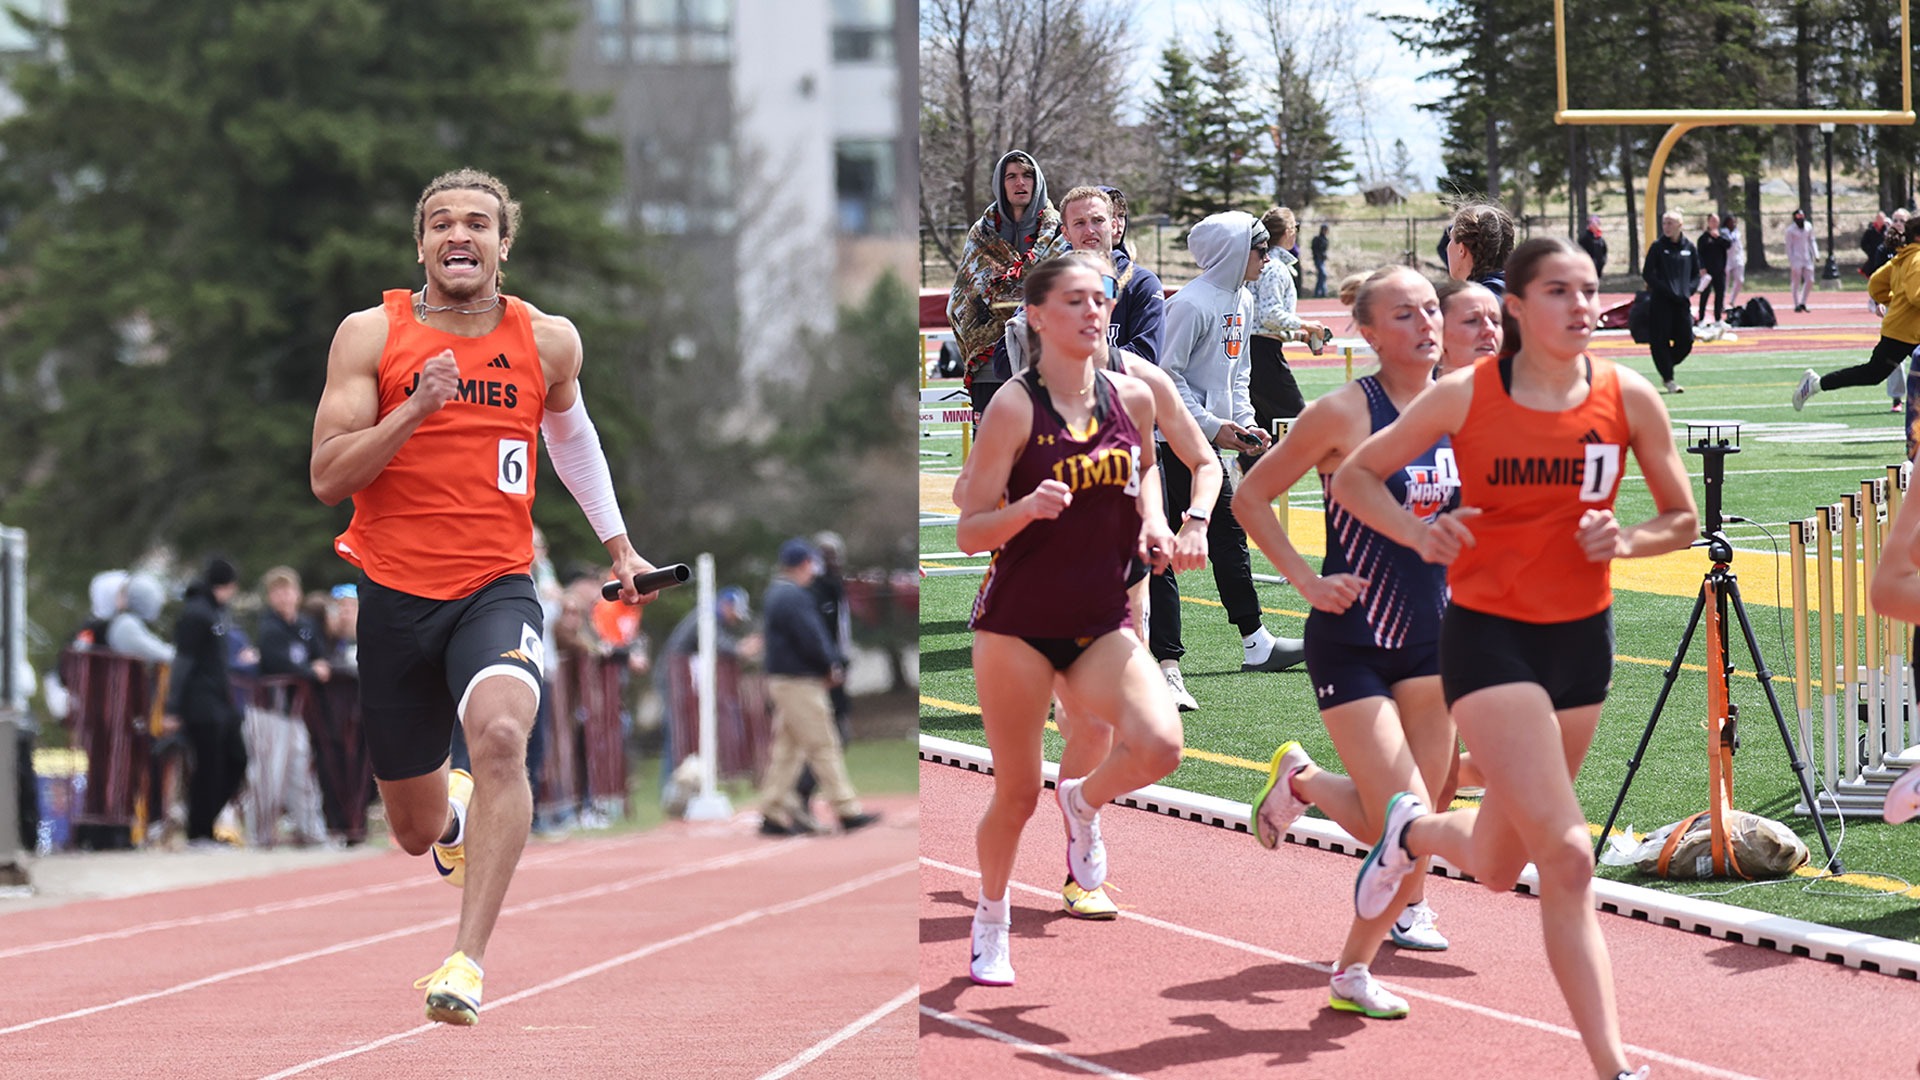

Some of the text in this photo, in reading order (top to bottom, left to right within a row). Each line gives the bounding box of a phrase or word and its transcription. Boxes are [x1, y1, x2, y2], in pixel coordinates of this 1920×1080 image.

[404, 372, 518, 409] JMIES
[942, 410, 973, 423] MINN
[502, 447, 523, 484] 6
[1052, 448, 1132, 493] UMD
[1487, 458, 1585, 486] JIMMIE
[1591, 455, 1605, 494] 1
[1405, 482, 1455, 510] MARY
